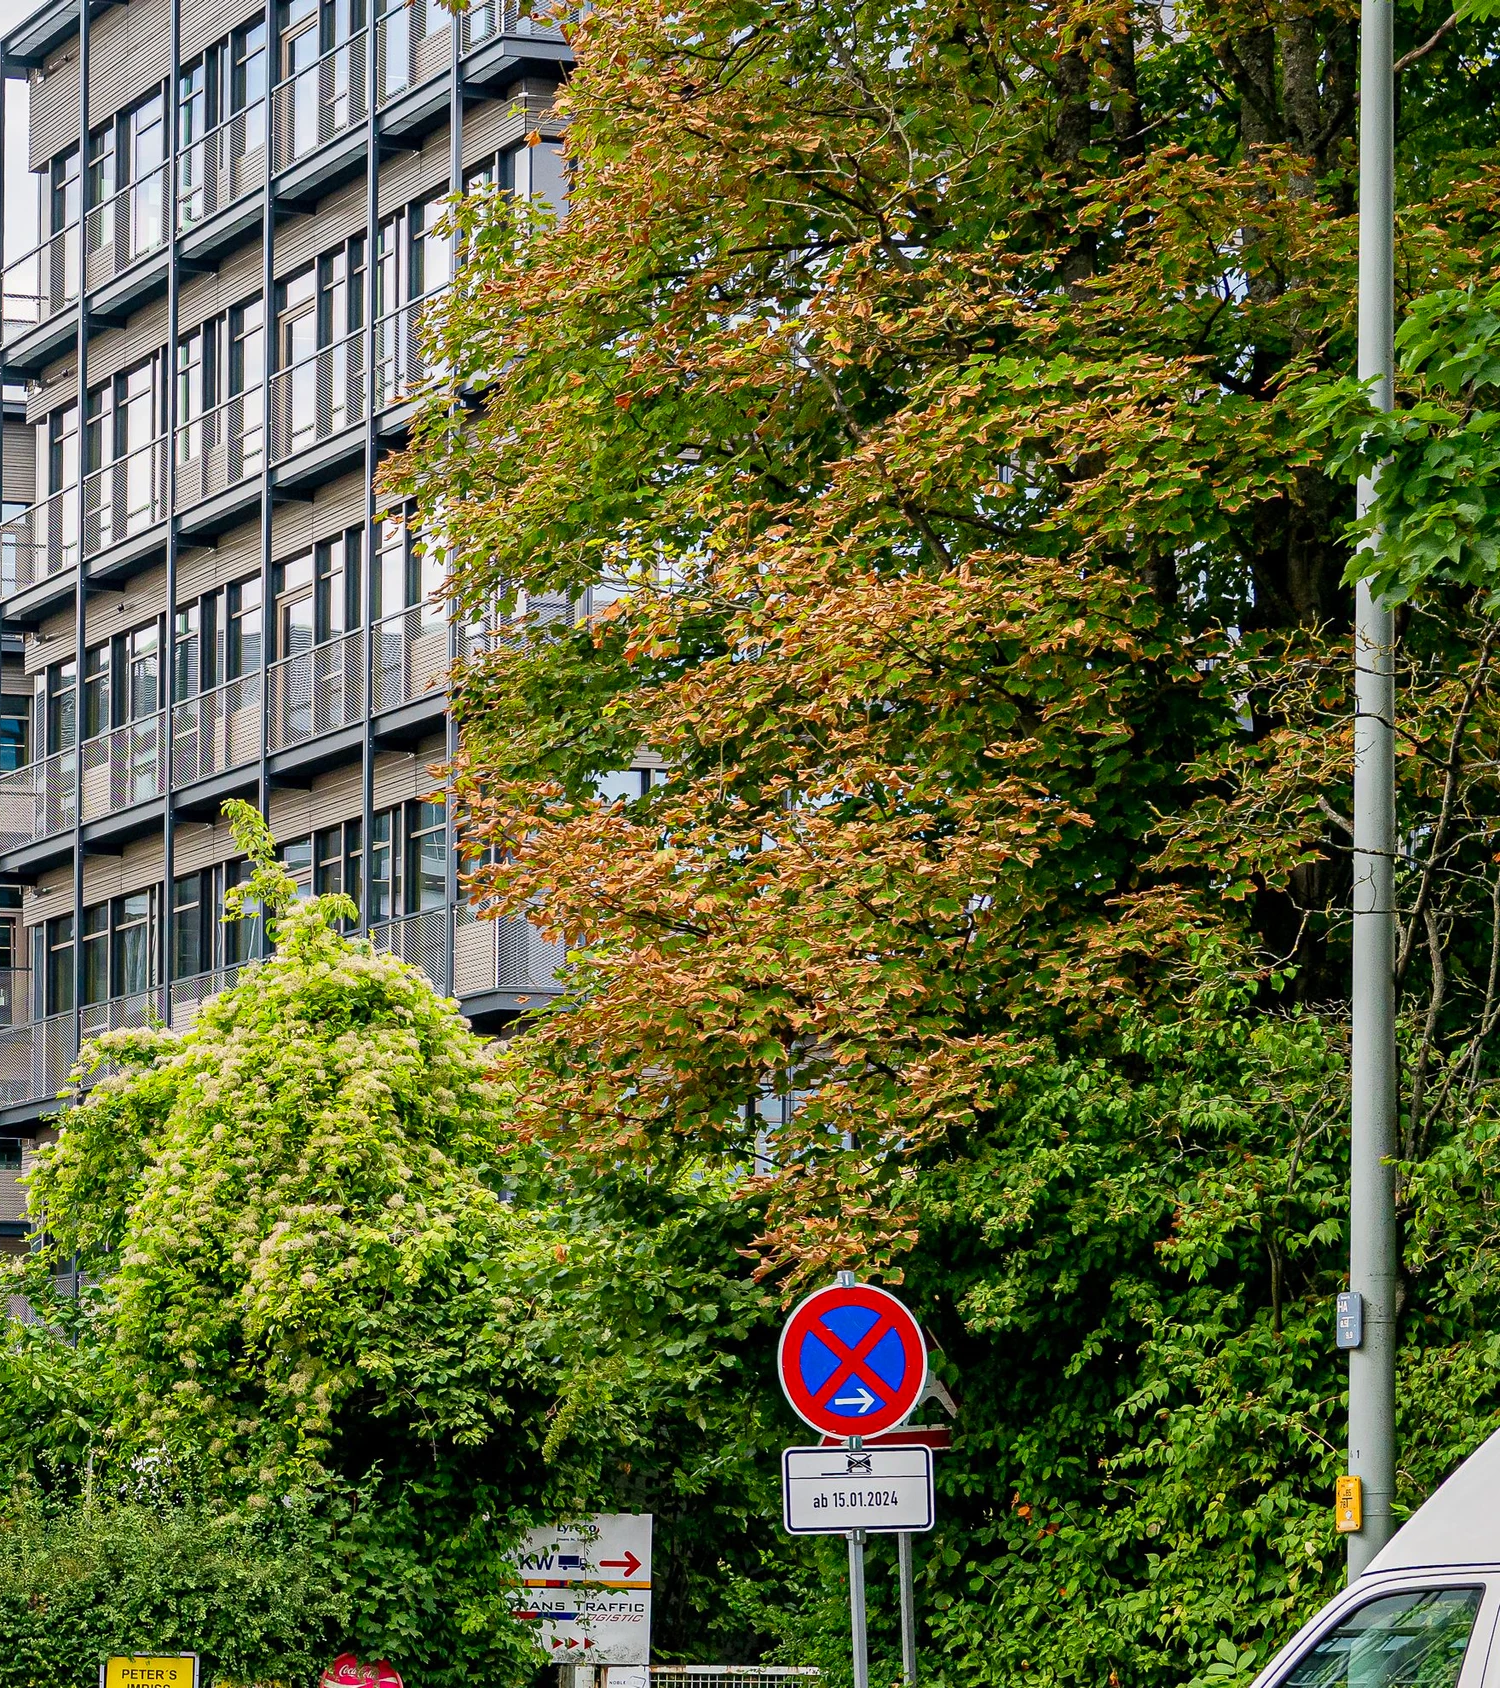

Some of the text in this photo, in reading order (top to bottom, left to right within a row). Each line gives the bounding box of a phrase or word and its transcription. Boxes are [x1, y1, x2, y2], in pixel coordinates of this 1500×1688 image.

[813, 1490, 898, 1508] ab 15.01.2024
[573, 1600, 645, 1612] TRAFFIC
